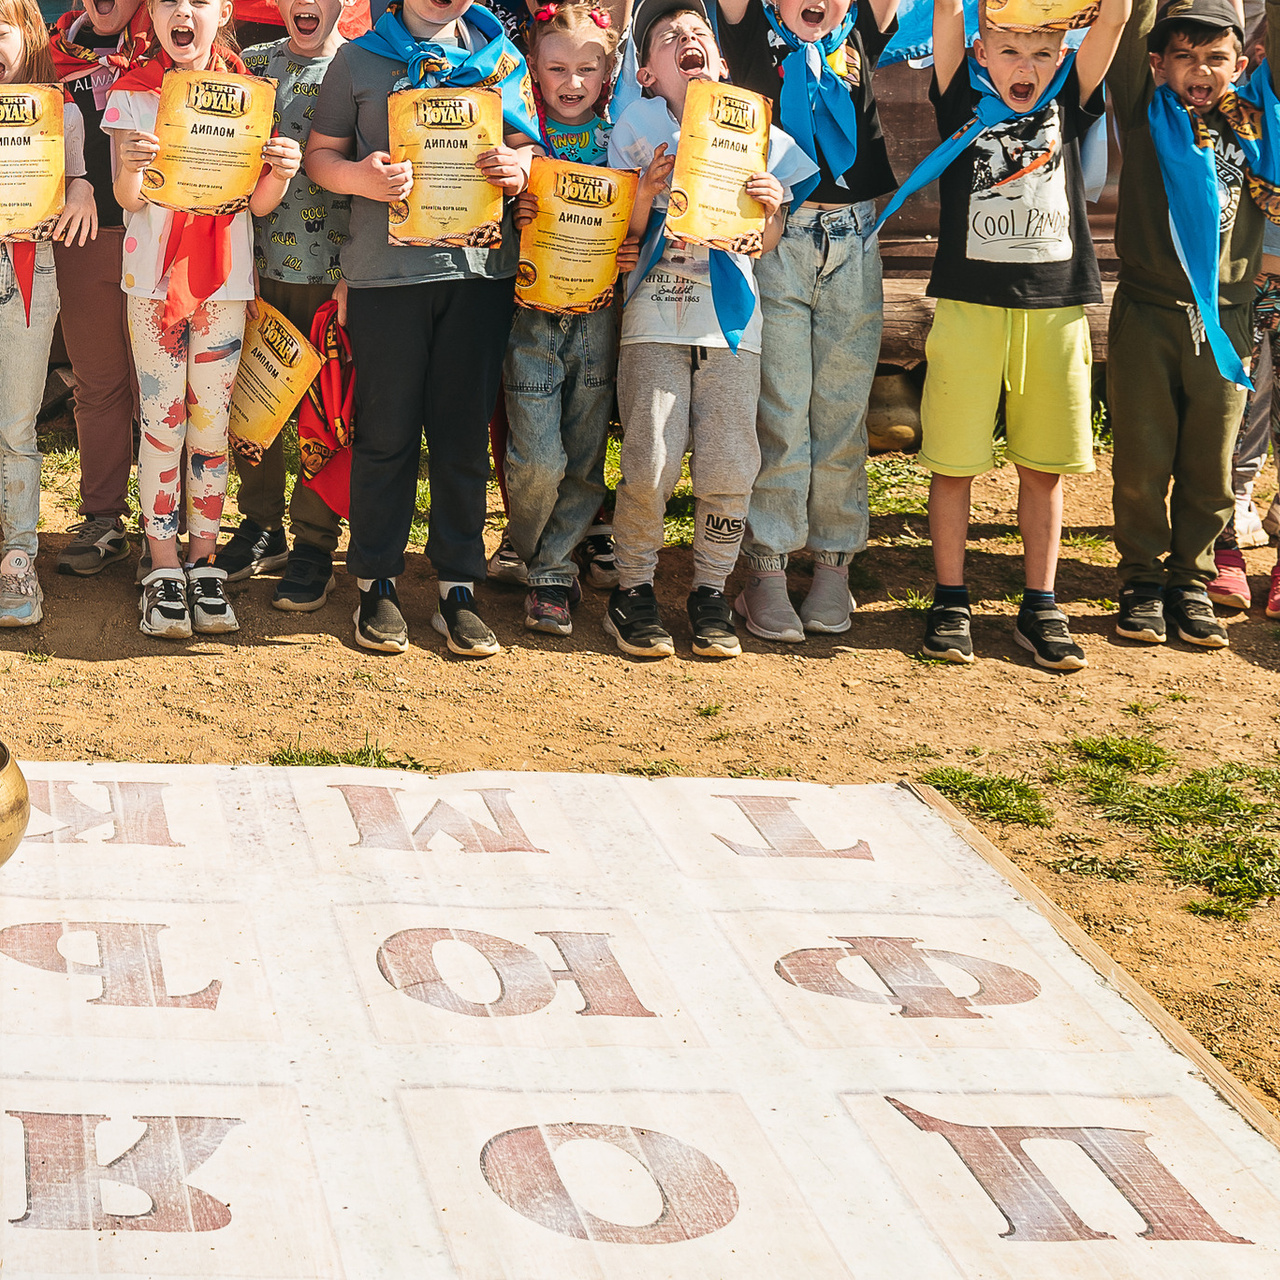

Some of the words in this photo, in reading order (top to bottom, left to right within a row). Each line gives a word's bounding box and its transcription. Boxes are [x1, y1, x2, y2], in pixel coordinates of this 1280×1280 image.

[73, 75, 115, 93] ALWA
[191, 123, 235, 138] ДИПЛОМ
[424, 139, 468, 149] ДИПЛОМ
[711, 137, 748, 153] ДИПЛОМ
[558, 211, 602, 226] ДИПЛОМ
[972, 210, 1024, 239] COOL
[1024, 208, 1067, 238] PANDA
[250, 346, 279, 380] ДИПЛОМ
[705, 514, 746, 532] NAS
[325, 784, 550, 854] М
[376, 927, 662, 1018] Ю
[774, 935, 1042, 1019] Ф
